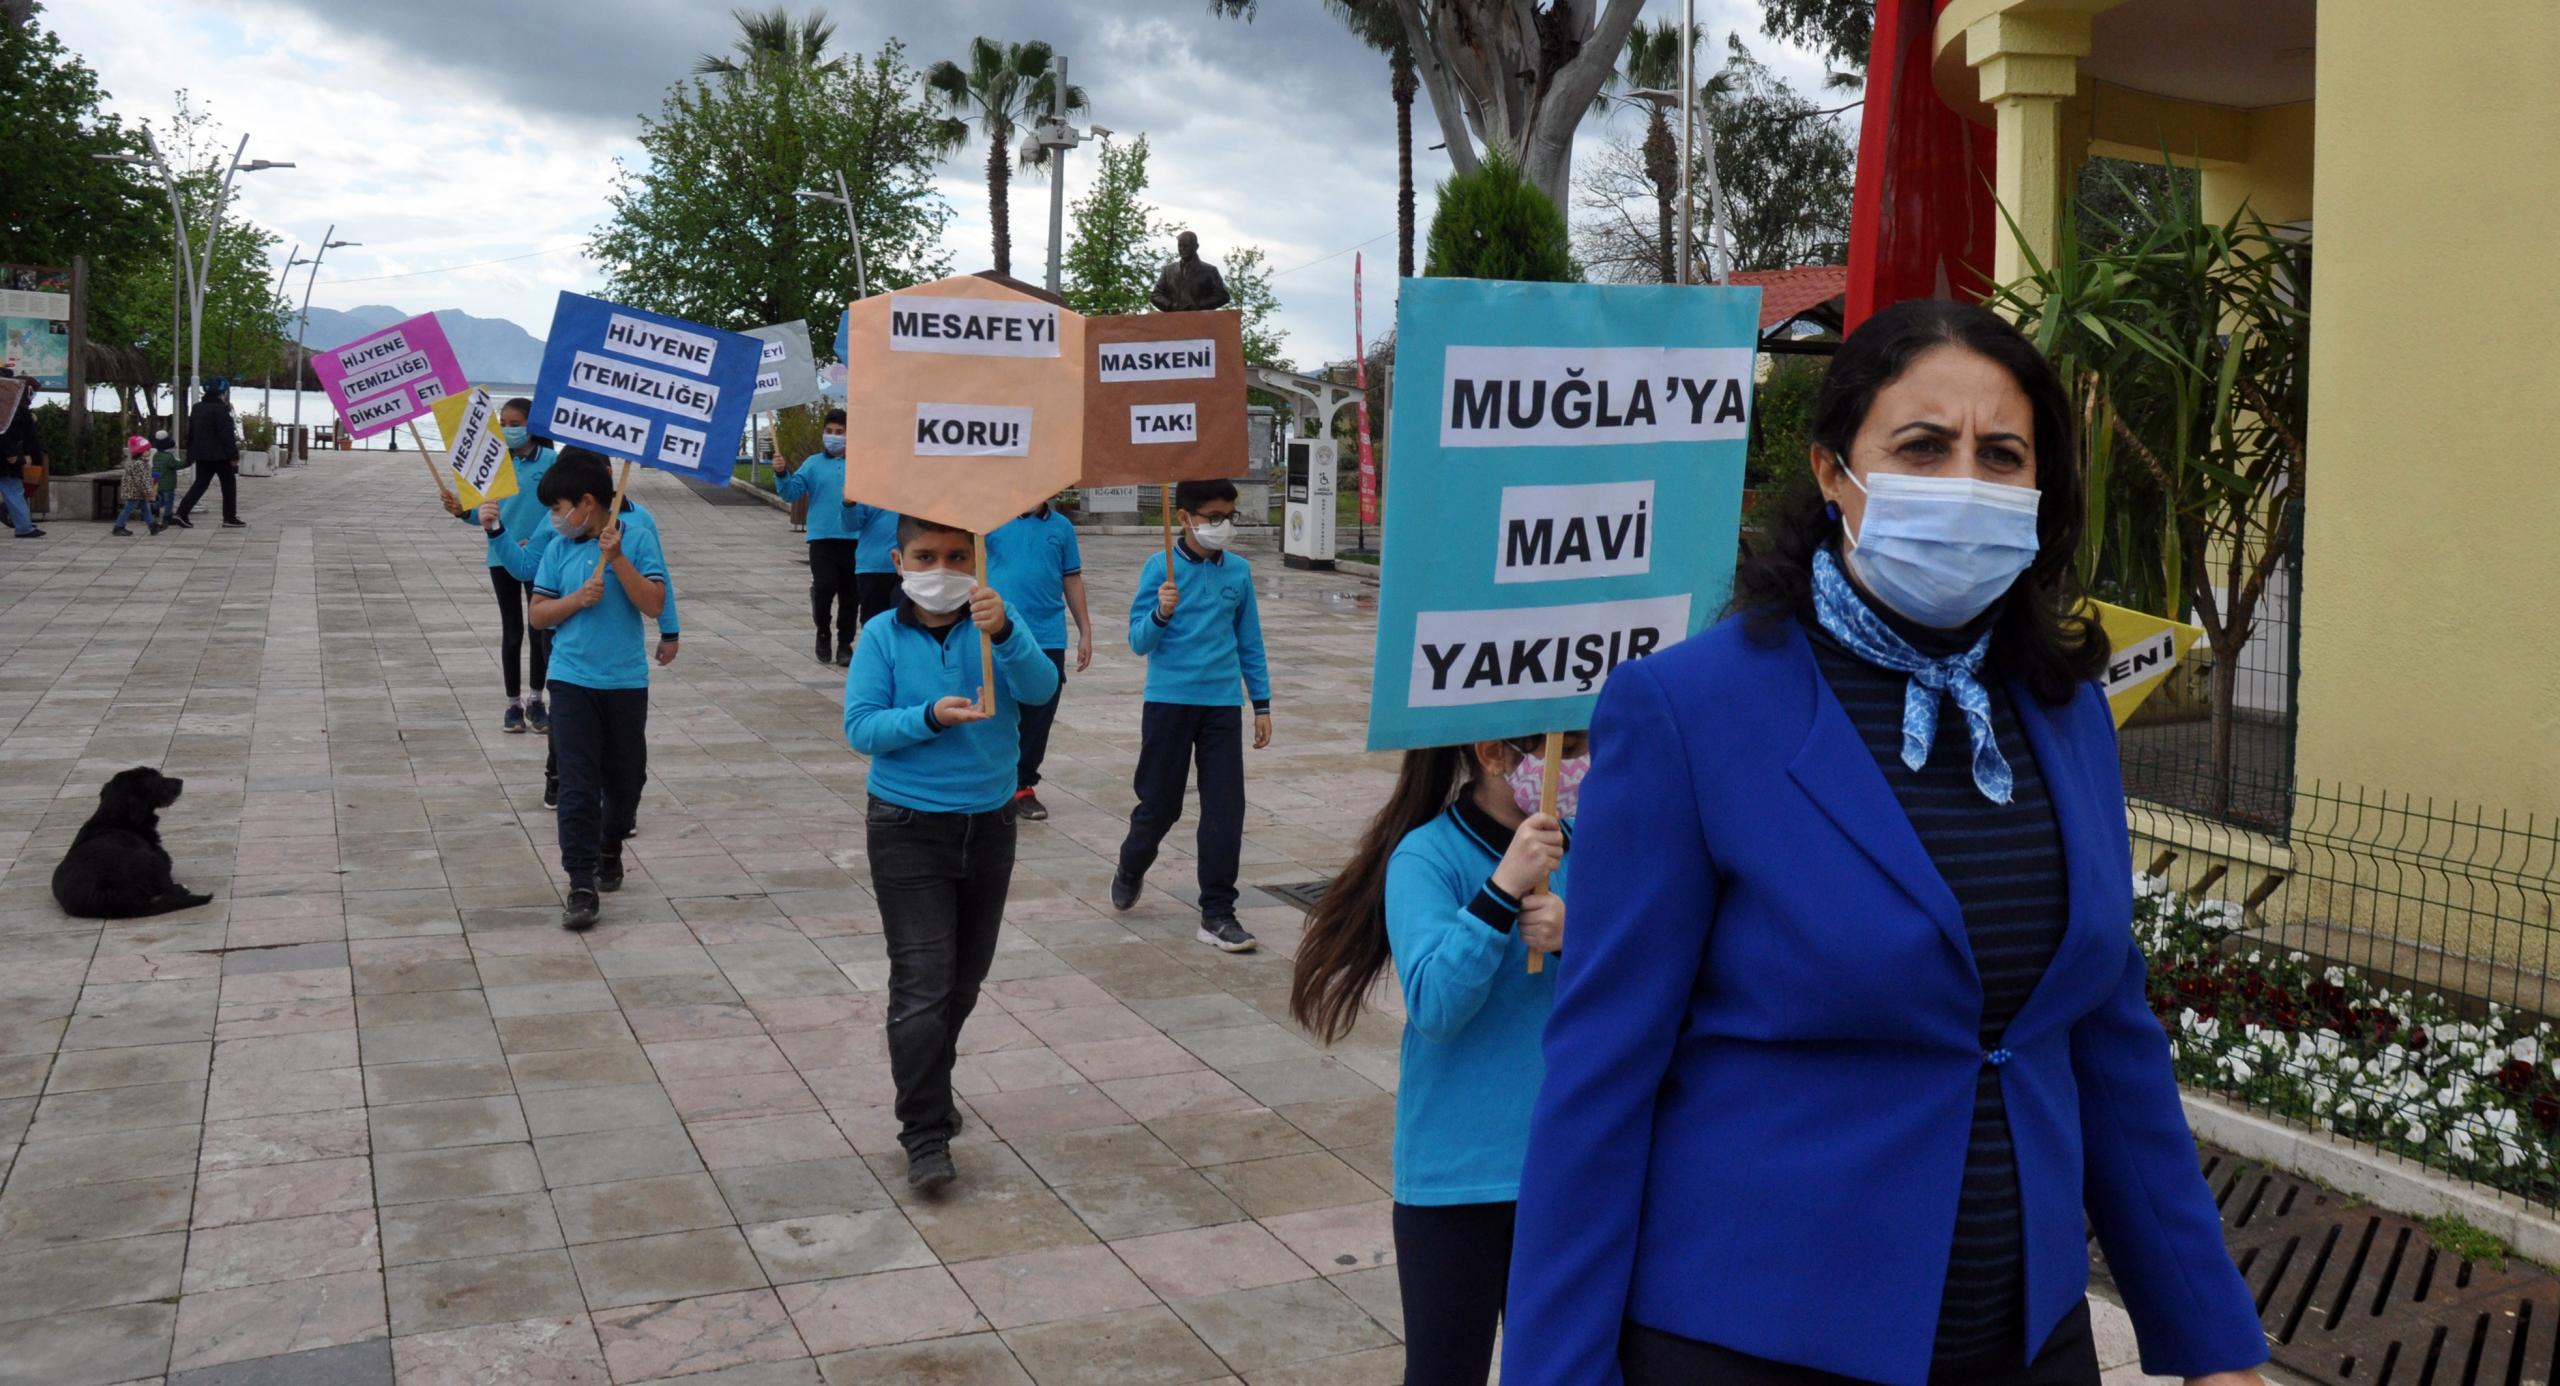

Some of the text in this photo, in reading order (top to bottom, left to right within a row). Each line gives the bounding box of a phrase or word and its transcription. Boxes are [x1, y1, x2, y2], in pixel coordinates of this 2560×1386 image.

[607, 324, 710, 364] HİJYENE
[892, 311, 1055, 342] MESAFEYİ
[341, 337, 405, 369] HİJYENE
[1101, 346, 1210, 371] MASKENİ
[343, 357, 429, 399] (TEMİZLİĞE)
[573, 361, 714, 415] (TEMİZLİĞE)
[1451, 367, 1746, 429] MUĞLA'YA
[350, 383, 442, 425] DİKKAT ET!
[1136, 414, 1192, 433] TAK!
[554, 407, 701, 458] DİKKAT ET!
[917, 418, 1019, 447] KORU!
[473, 438, 502, 490] KORU!
[1506, 500, 1647, 567] MAVİ
[2100, 635, 2173, 687] ENİ
